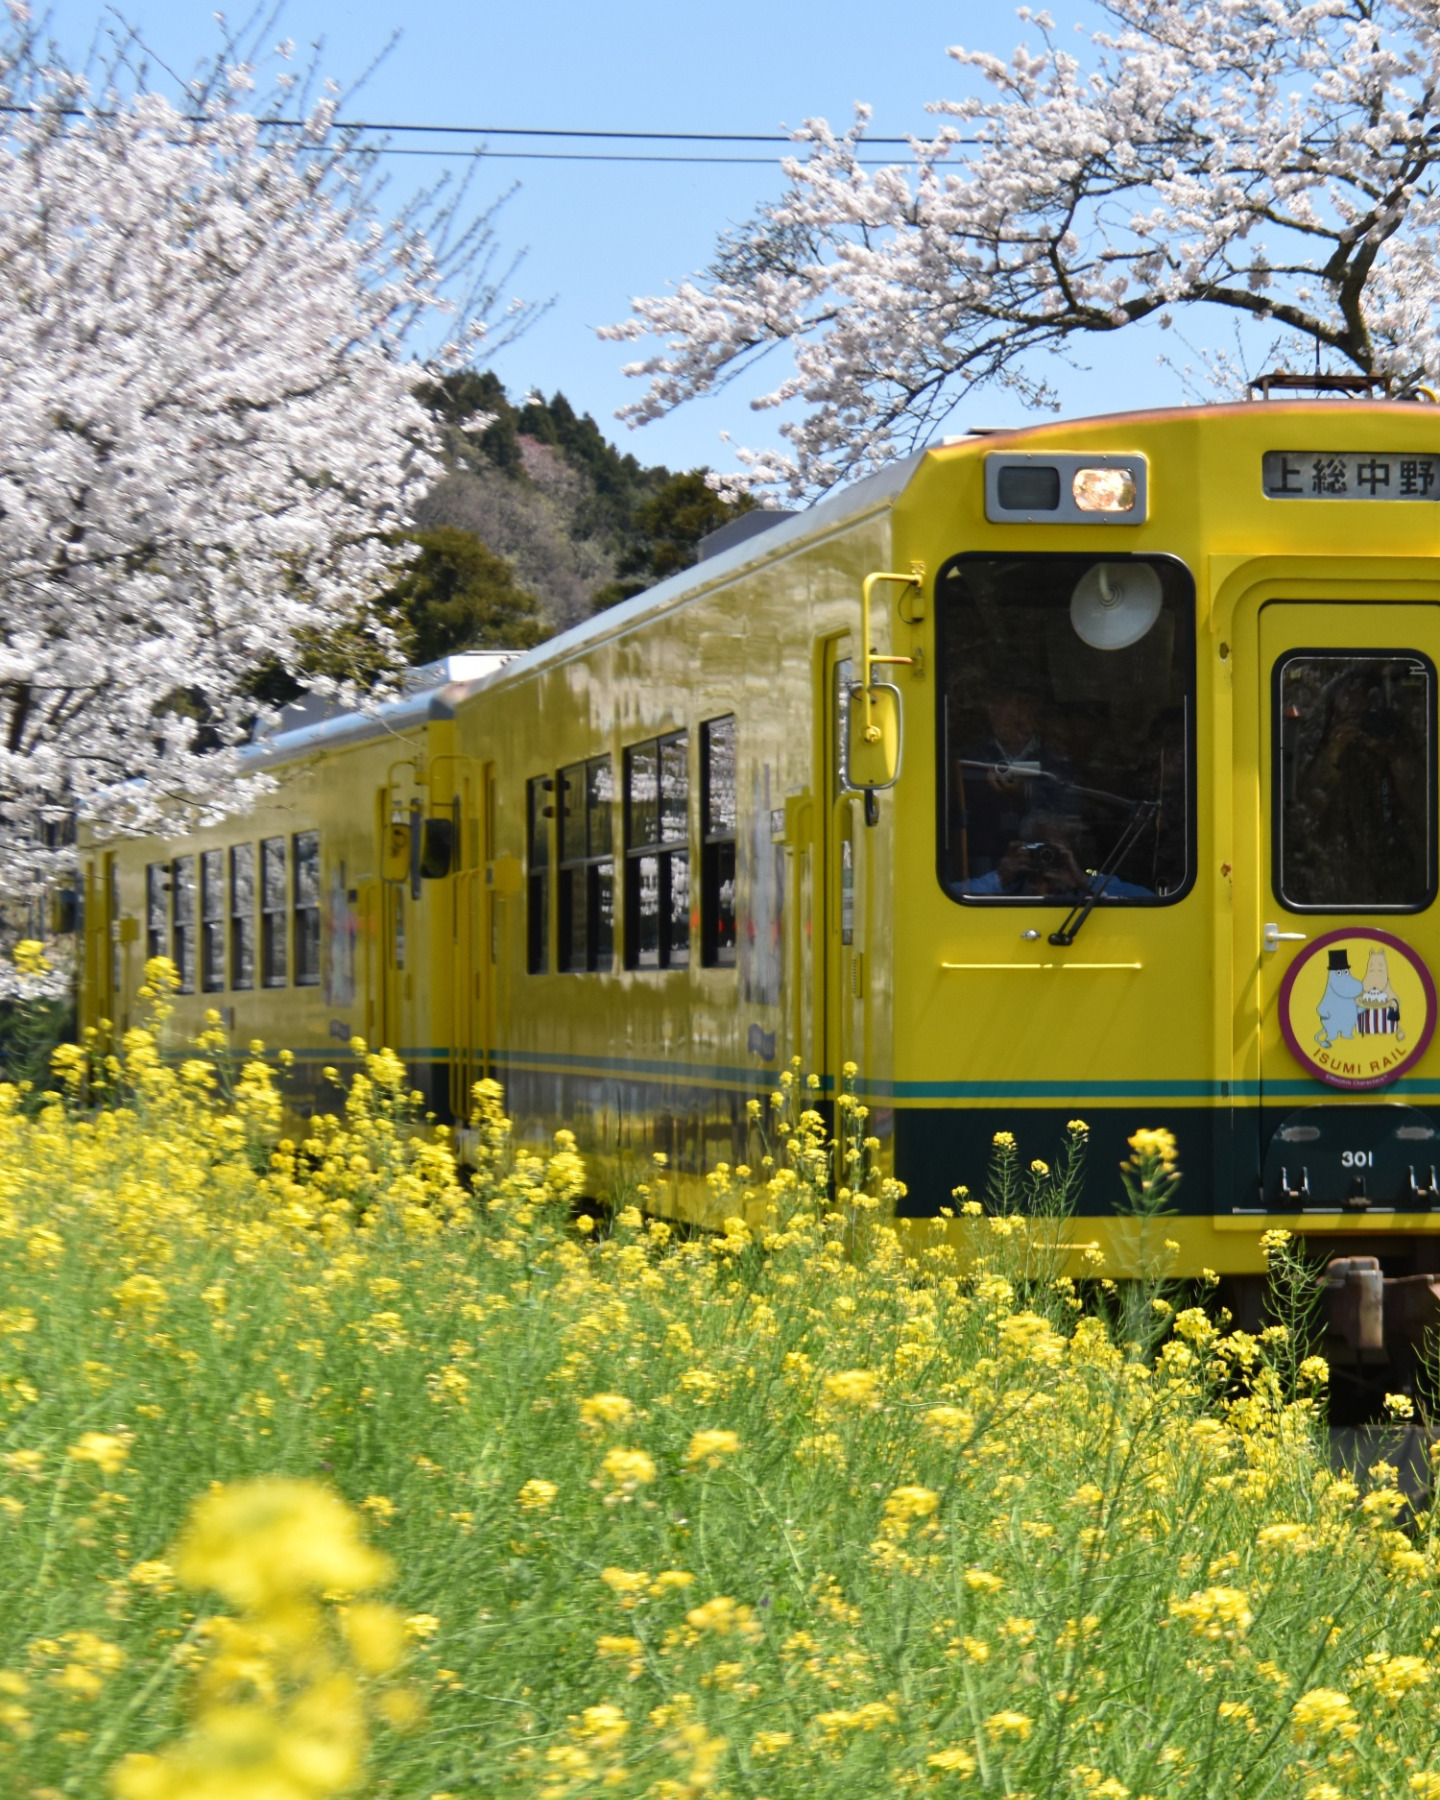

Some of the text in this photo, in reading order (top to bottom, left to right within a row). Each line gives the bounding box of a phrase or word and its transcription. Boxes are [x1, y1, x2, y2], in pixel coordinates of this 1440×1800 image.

[1269, 457, 1436, 496] 上総中野
[1313, 1046, 1407, 1074] ISUMI RAIL
[1341, 1150, 1373, 1168] 301
